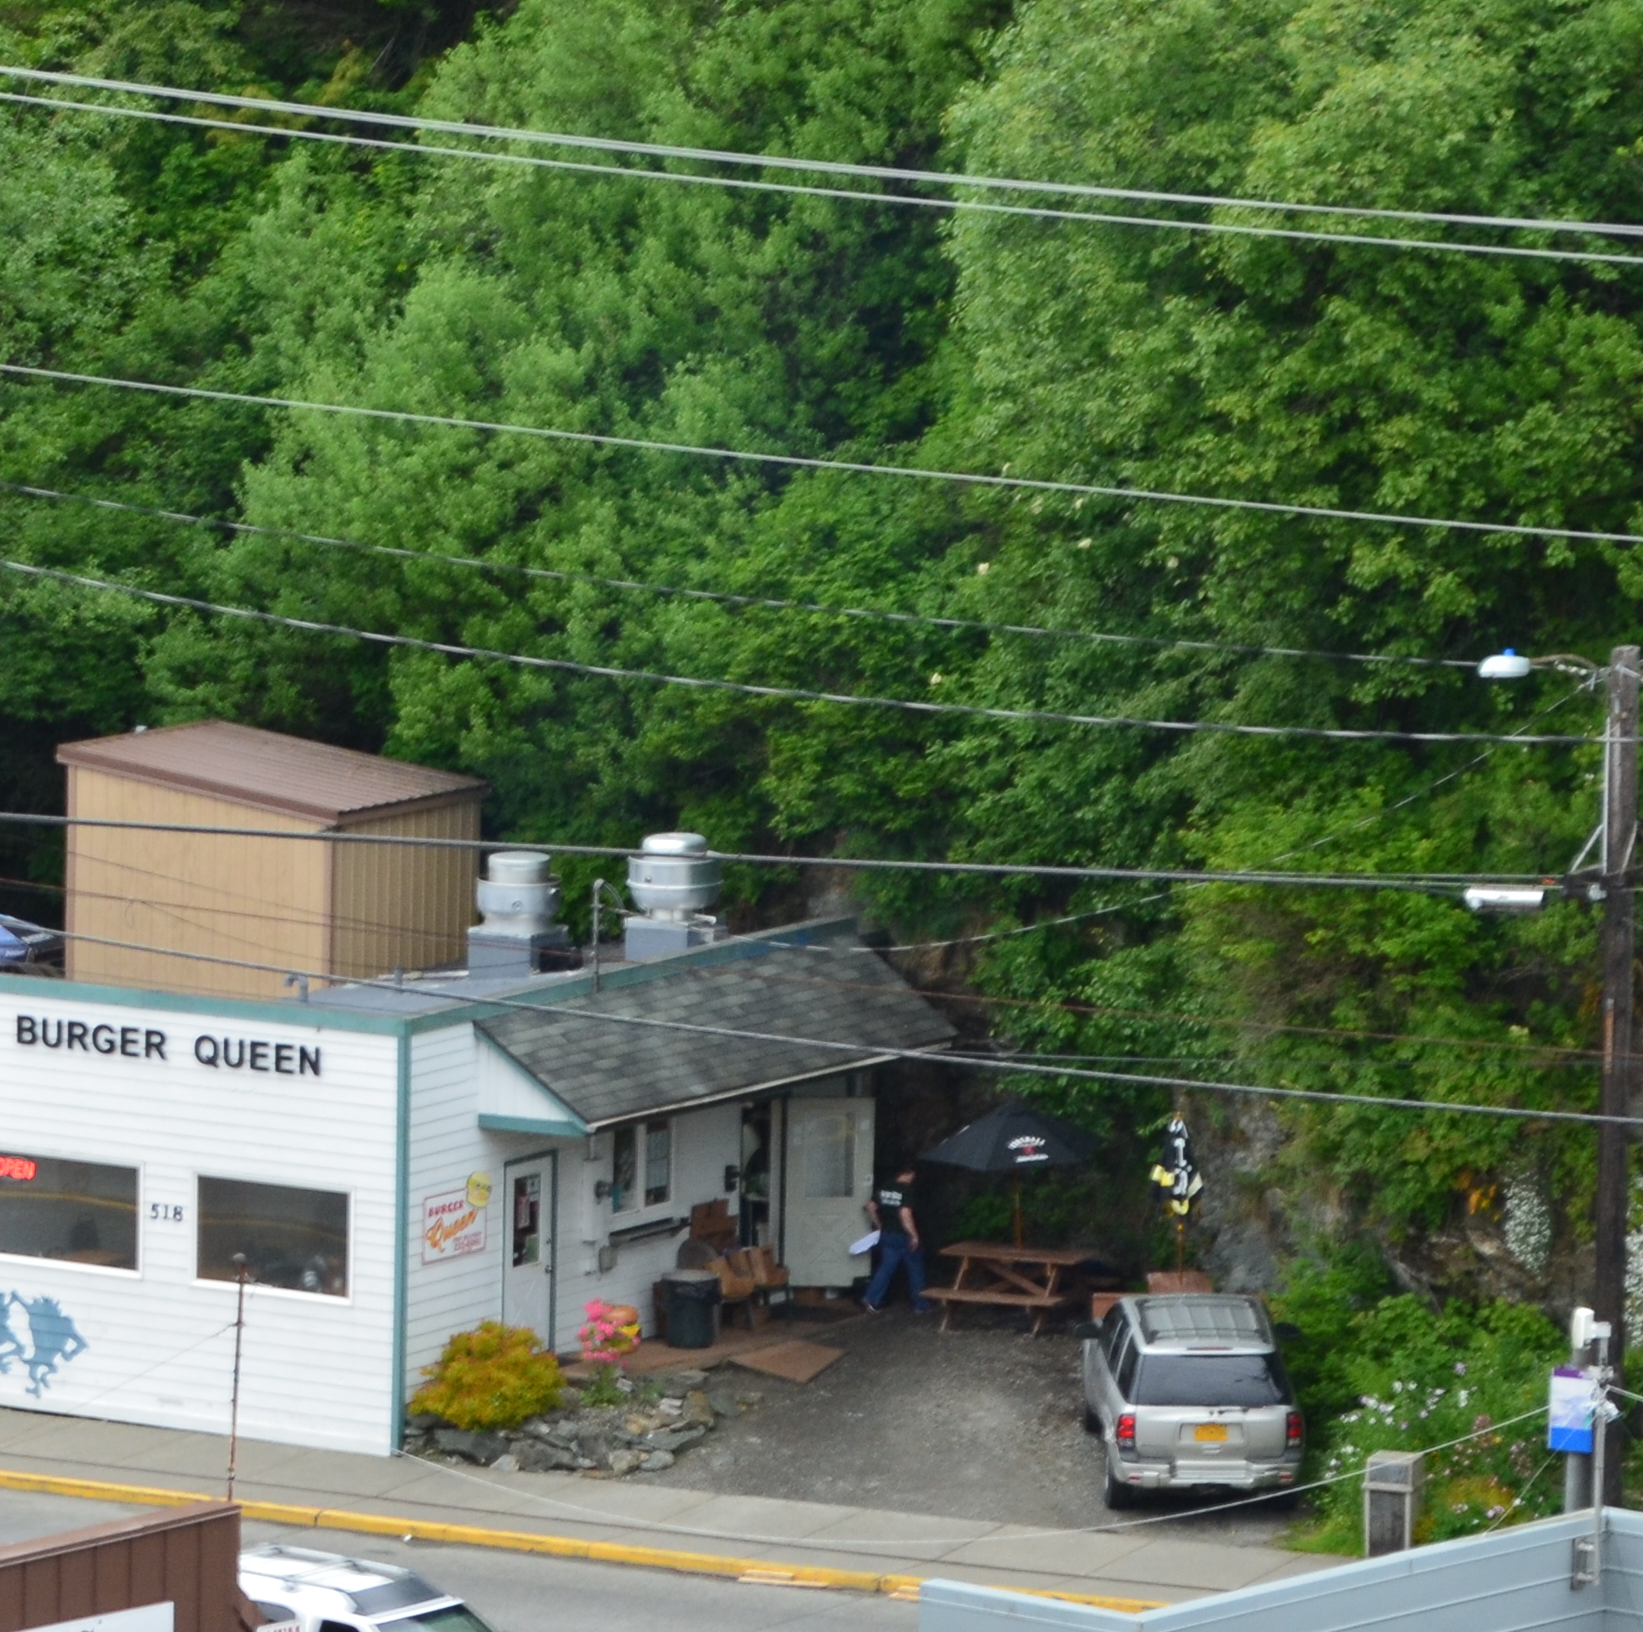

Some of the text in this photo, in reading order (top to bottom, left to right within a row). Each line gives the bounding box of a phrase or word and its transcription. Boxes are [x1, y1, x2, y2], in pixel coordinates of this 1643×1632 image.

[16, 1015, 321, 1076] BURGER QUEEN
[150, 1203, 184, 1222] 518
[428, 1200, 465, 1217] BURGER
[426, 1207, 478, 1252] Queen
